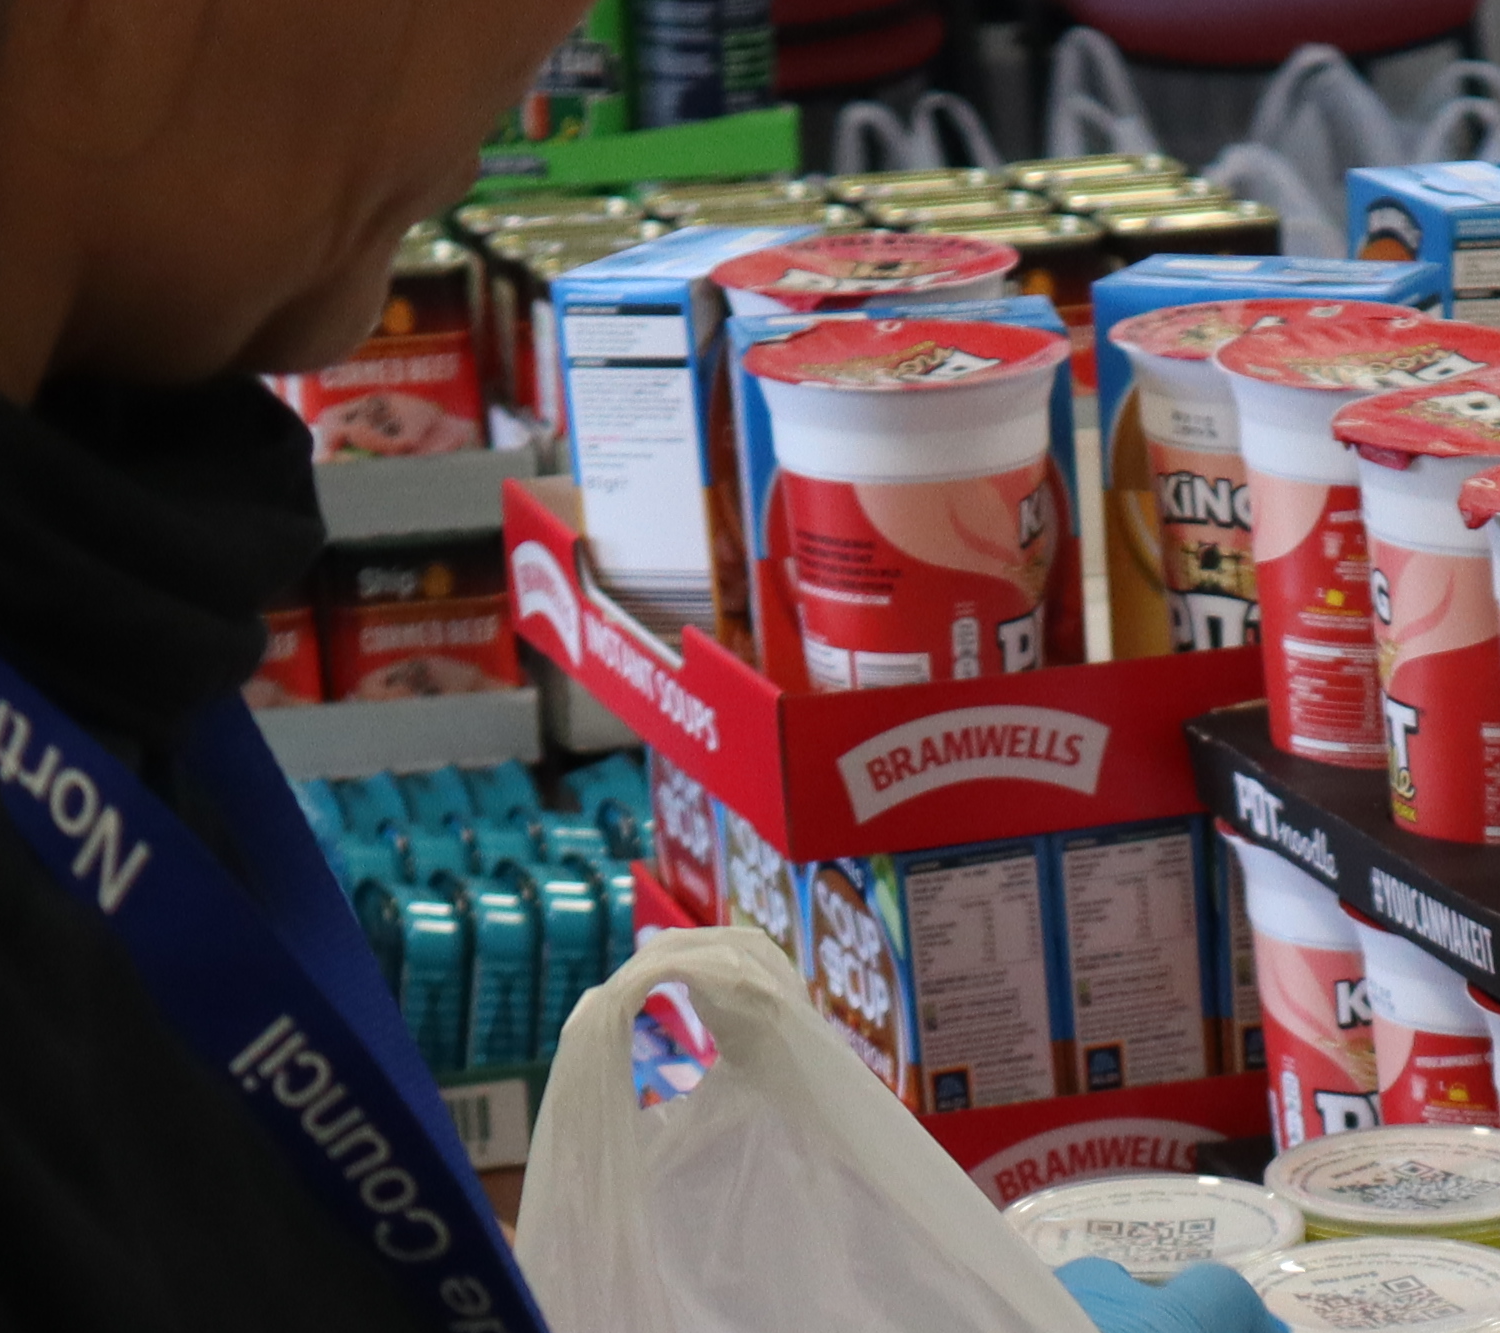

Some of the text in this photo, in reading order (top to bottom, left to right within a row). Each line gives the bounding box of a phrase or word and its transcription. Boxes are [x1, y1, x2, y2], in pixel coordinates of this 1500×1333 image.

[582, 610, 655, 698] INSTANT
[654, 680, 719, 751] SOUPS
[866, 724, 1083, 792] BRAMWELLS
[1233, 771, 1339, 881] POT noodle
[1369, 866, 1495, 975] #YOUCANMAKEIT
[229, 1013, 451, 1262] Council
[994, 1136, 1199, 1200] BRAMWELLS
